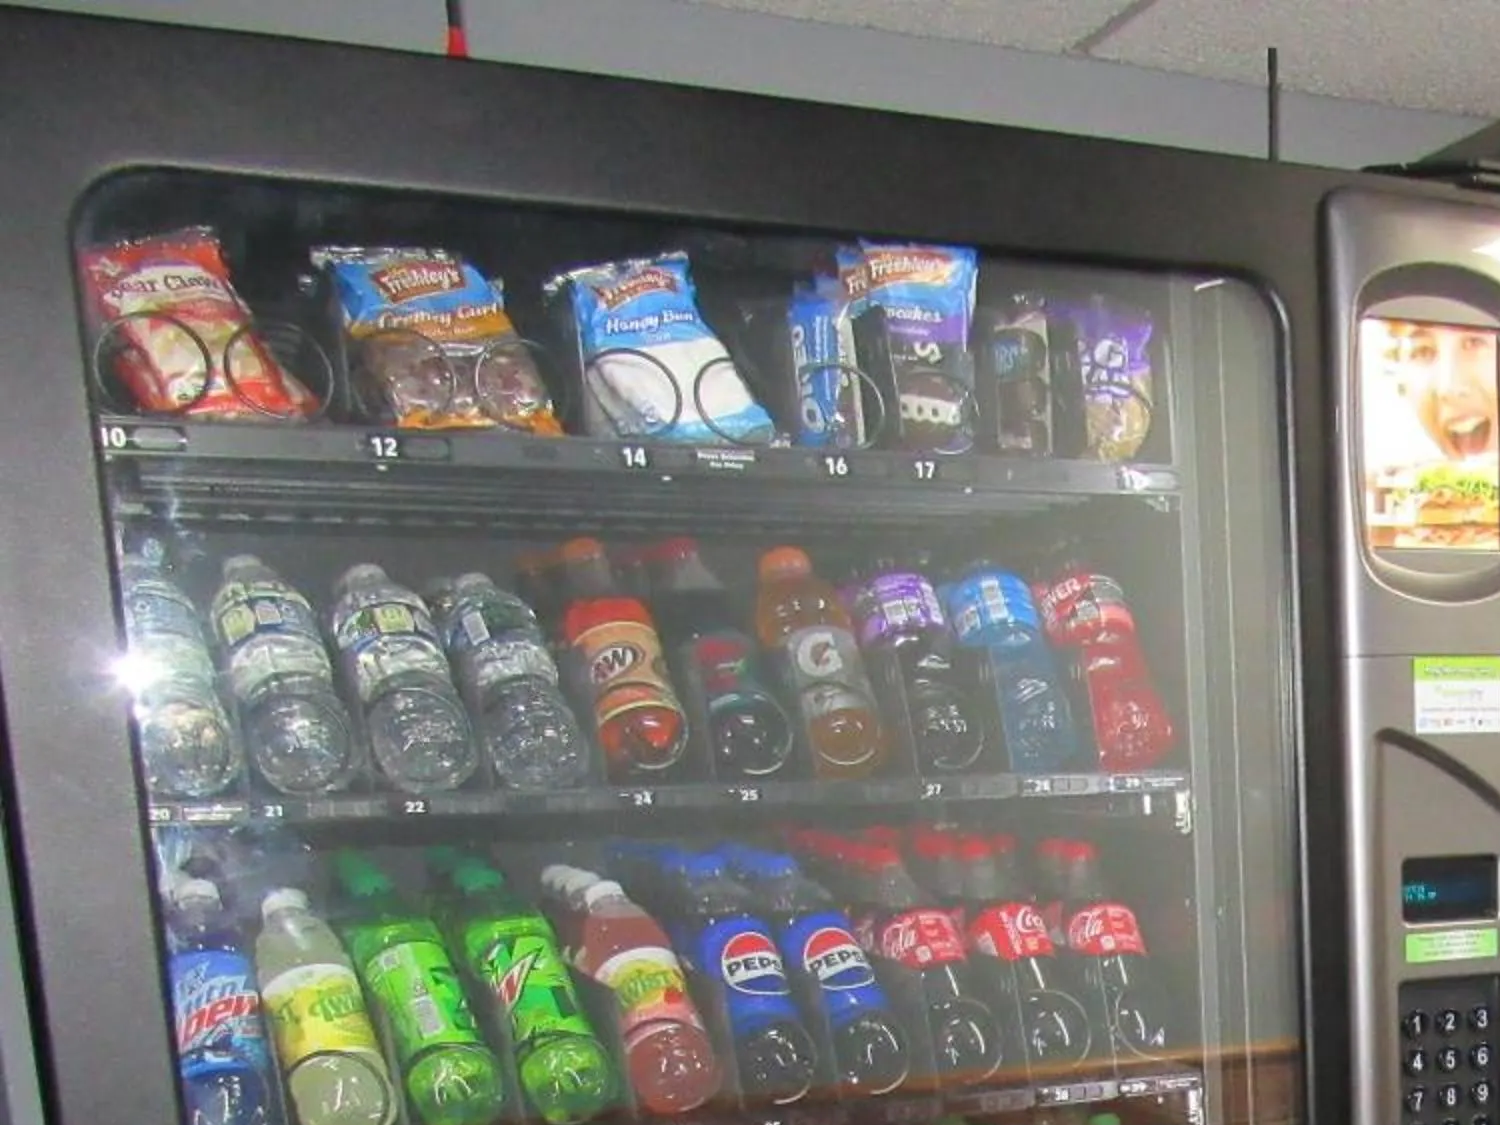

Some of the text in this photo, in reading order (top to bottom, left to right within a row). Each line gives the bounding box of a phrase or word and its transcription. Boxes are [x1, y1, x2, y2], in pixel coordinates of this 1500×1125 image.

[101, 427, 126, 446] 10
[371, 437, 398, 457] 12
[622, 447, 647, 467] 14
[825, 457, 848, 476] 16
[915, 462, 936, 479] 17
[405, 801, 426, 813] 22
[726, 955, 783, 977] PEPS
[809, 950, 866, 972] PEPS
[1412, 1015, 1422, 1034] 1
[1445, 1013, 1456, 1031] 2
[1476, 1009, 1488, 1029] 3
[1412, 1053, 1423, 1072] 4
[1445, 1050, 1456, 1069] 5
[1477, 1046, 1488, 1065] 6
[1413, 1092, 1423, 1112] 7
[1446, 1087, 1456, 1106] 8
[1477, 1084, 1488, 1104] 9
